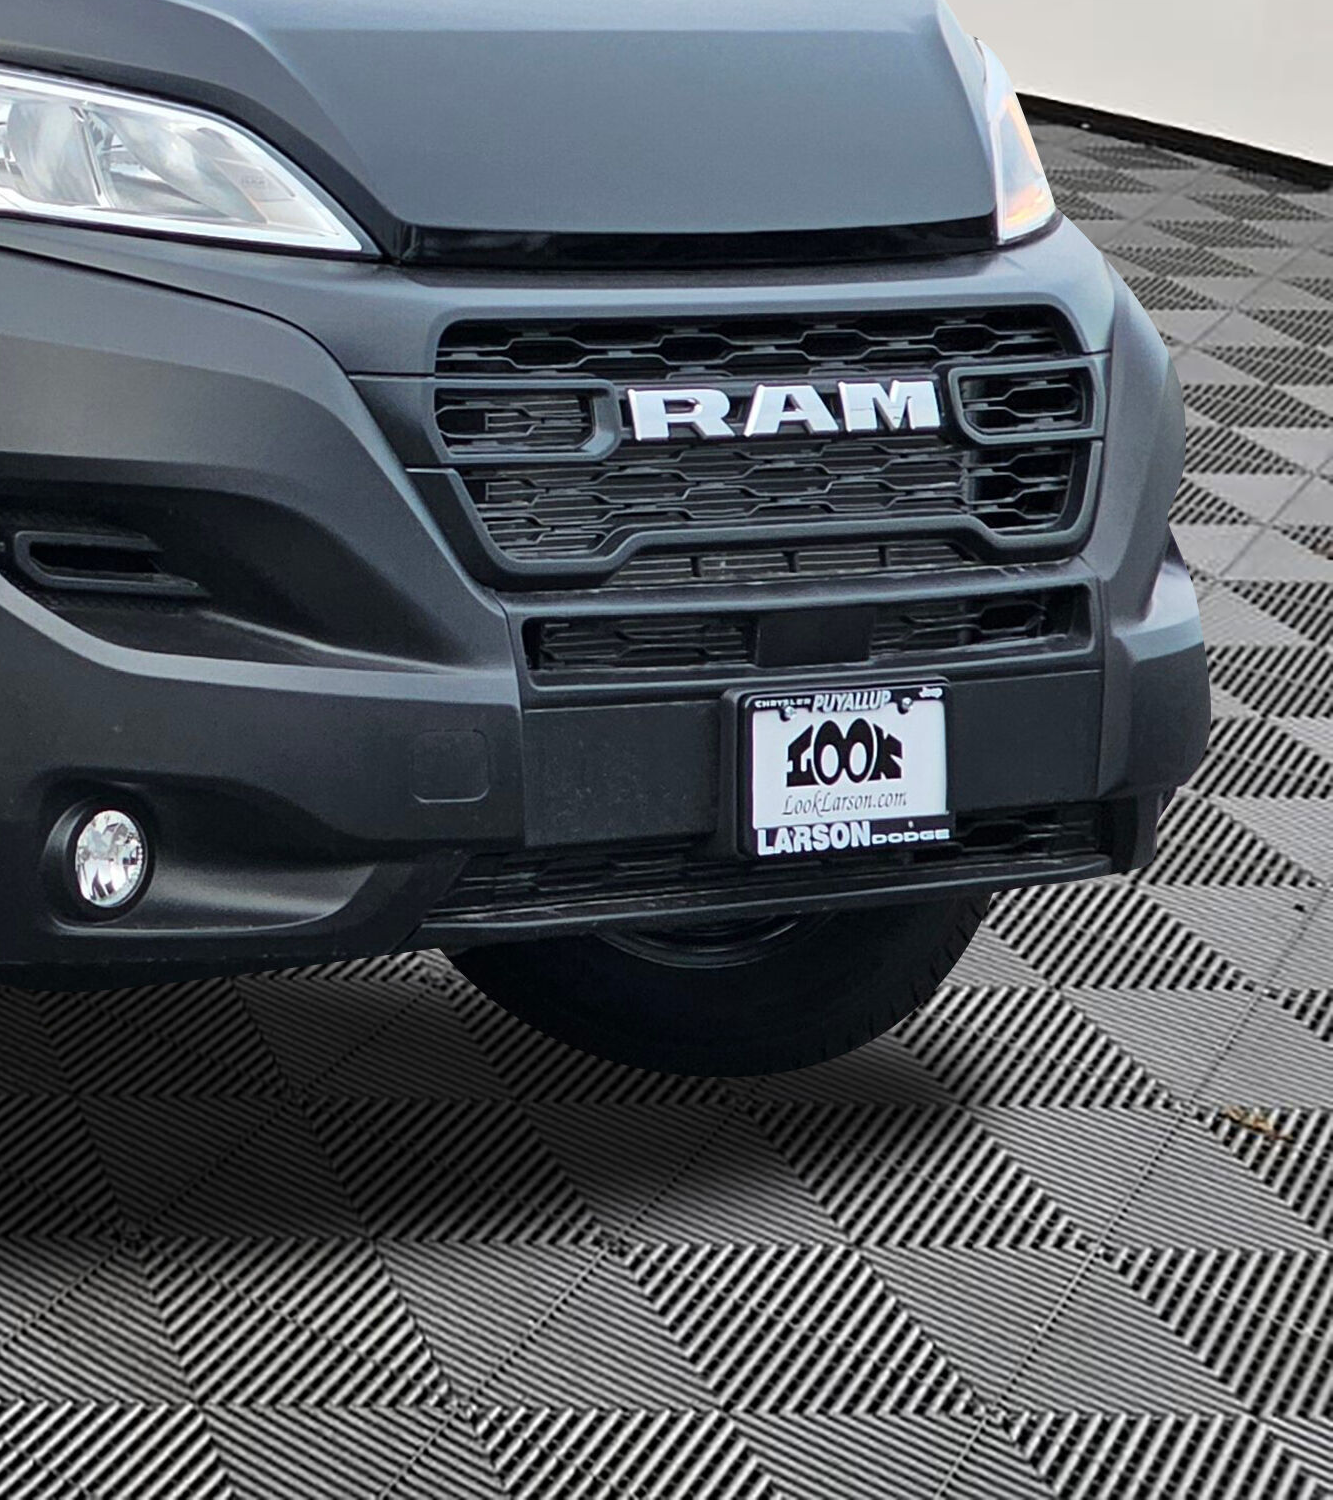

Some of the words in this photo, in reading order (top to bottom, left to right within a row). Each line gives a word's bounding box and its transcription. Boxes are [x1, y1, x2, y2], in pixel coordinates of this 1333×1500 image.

[627, 379, 941, 442] RAM
[754, 698, 812, 708] CHRYSLER
[812, 690, 892, 713] PUYALLUP
[786, 718, 904, 788] LOOK
[781, 790, 907, 817] LookLarson.com
[757, 820, 871, 856] LARSON
[871, 828, 951, 845] DODGE
